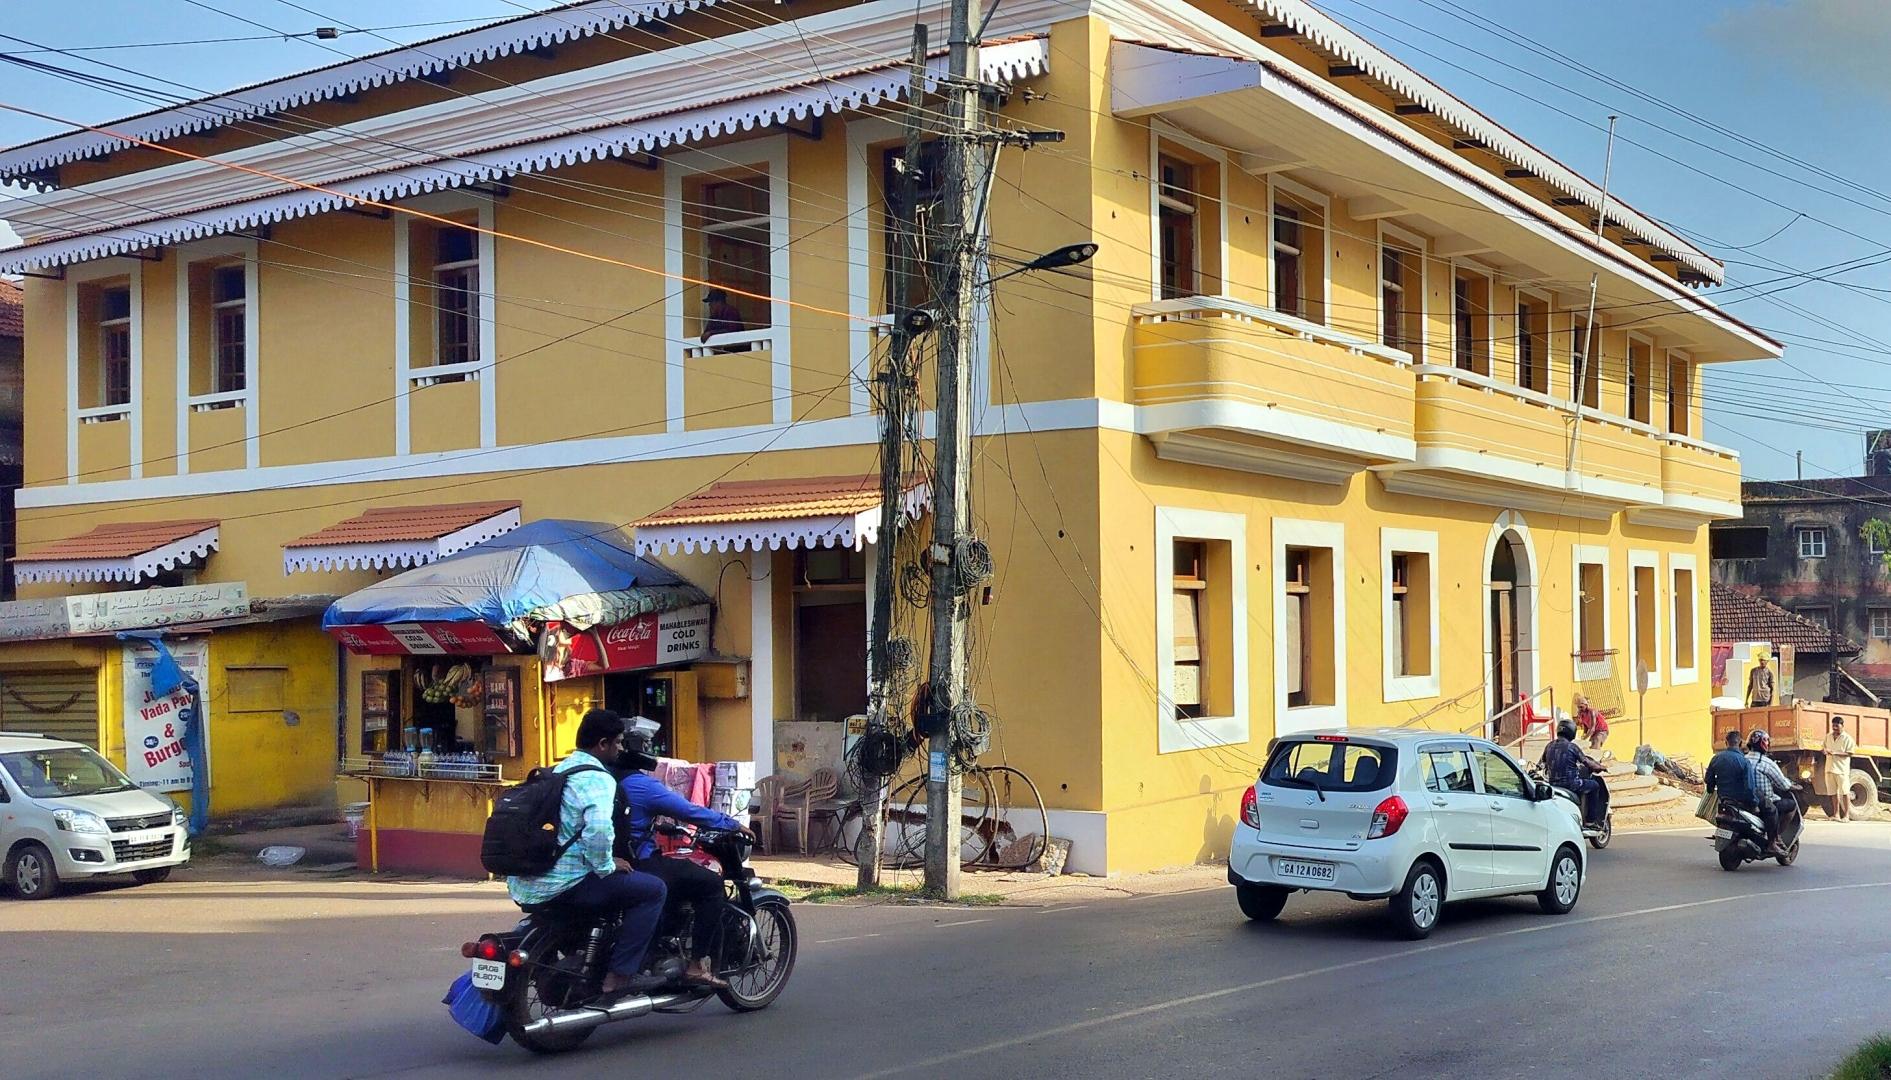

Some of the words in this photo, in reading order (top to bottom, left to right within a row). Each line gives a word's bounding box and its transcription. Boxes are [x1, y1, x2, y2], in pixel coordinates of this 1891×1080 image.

[672, 629, 696, 640] COLD
[667, 640, 700, 653] DRINKS
[141, 703, 170, 720] Vada
[171, 694, 192, 709] Pav
[164, 723, 174, 738] &
